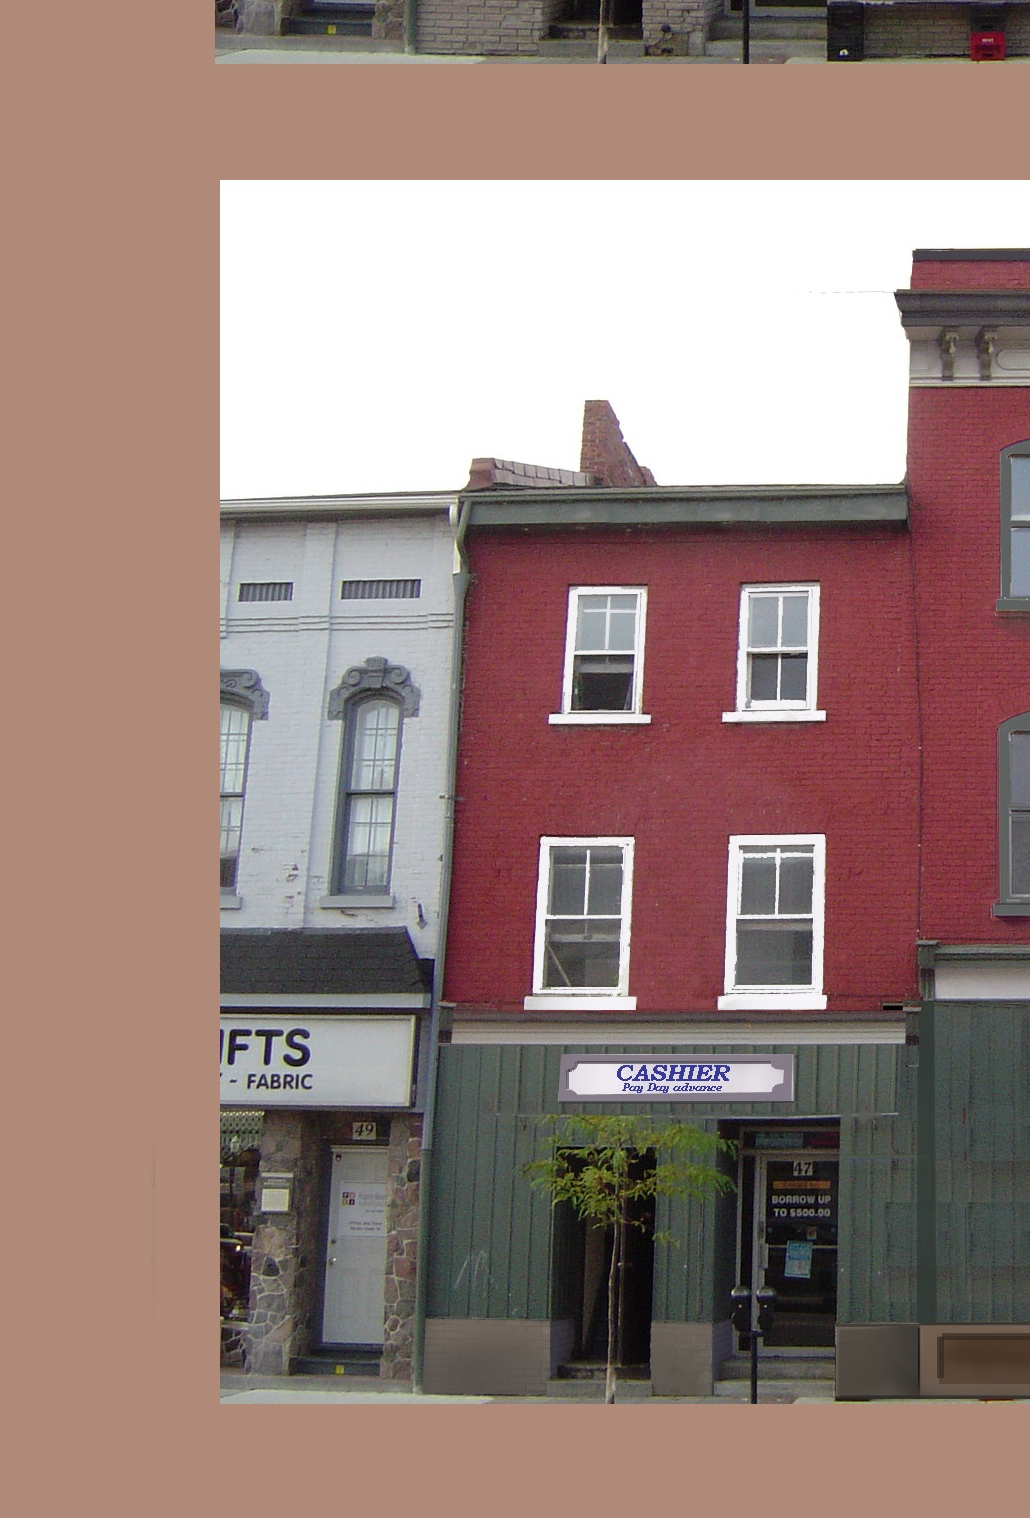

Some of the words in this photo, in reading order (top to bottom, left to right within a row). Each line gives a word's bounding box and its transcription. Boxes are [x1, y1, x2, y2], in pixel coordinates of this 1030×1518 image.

[616, 1064, 731, 1082] CASHIER
[246, 1073, 313, 1090] FABRIC
[621, 1082, 644, 1094] Pay
[647, 1082, 670, 1094] Day
[672, 1082, 723, 1093] advance
[354, 1123, 375, 1138] 49
[793, 1162, 812, 1175] 47
[771, 1195, 816, 1204] BORROW
[817, 1195, 832, 1204] UP
[773, 1208, 788, 1217] TO
[789, 1208, 831, 1217] $500.00
